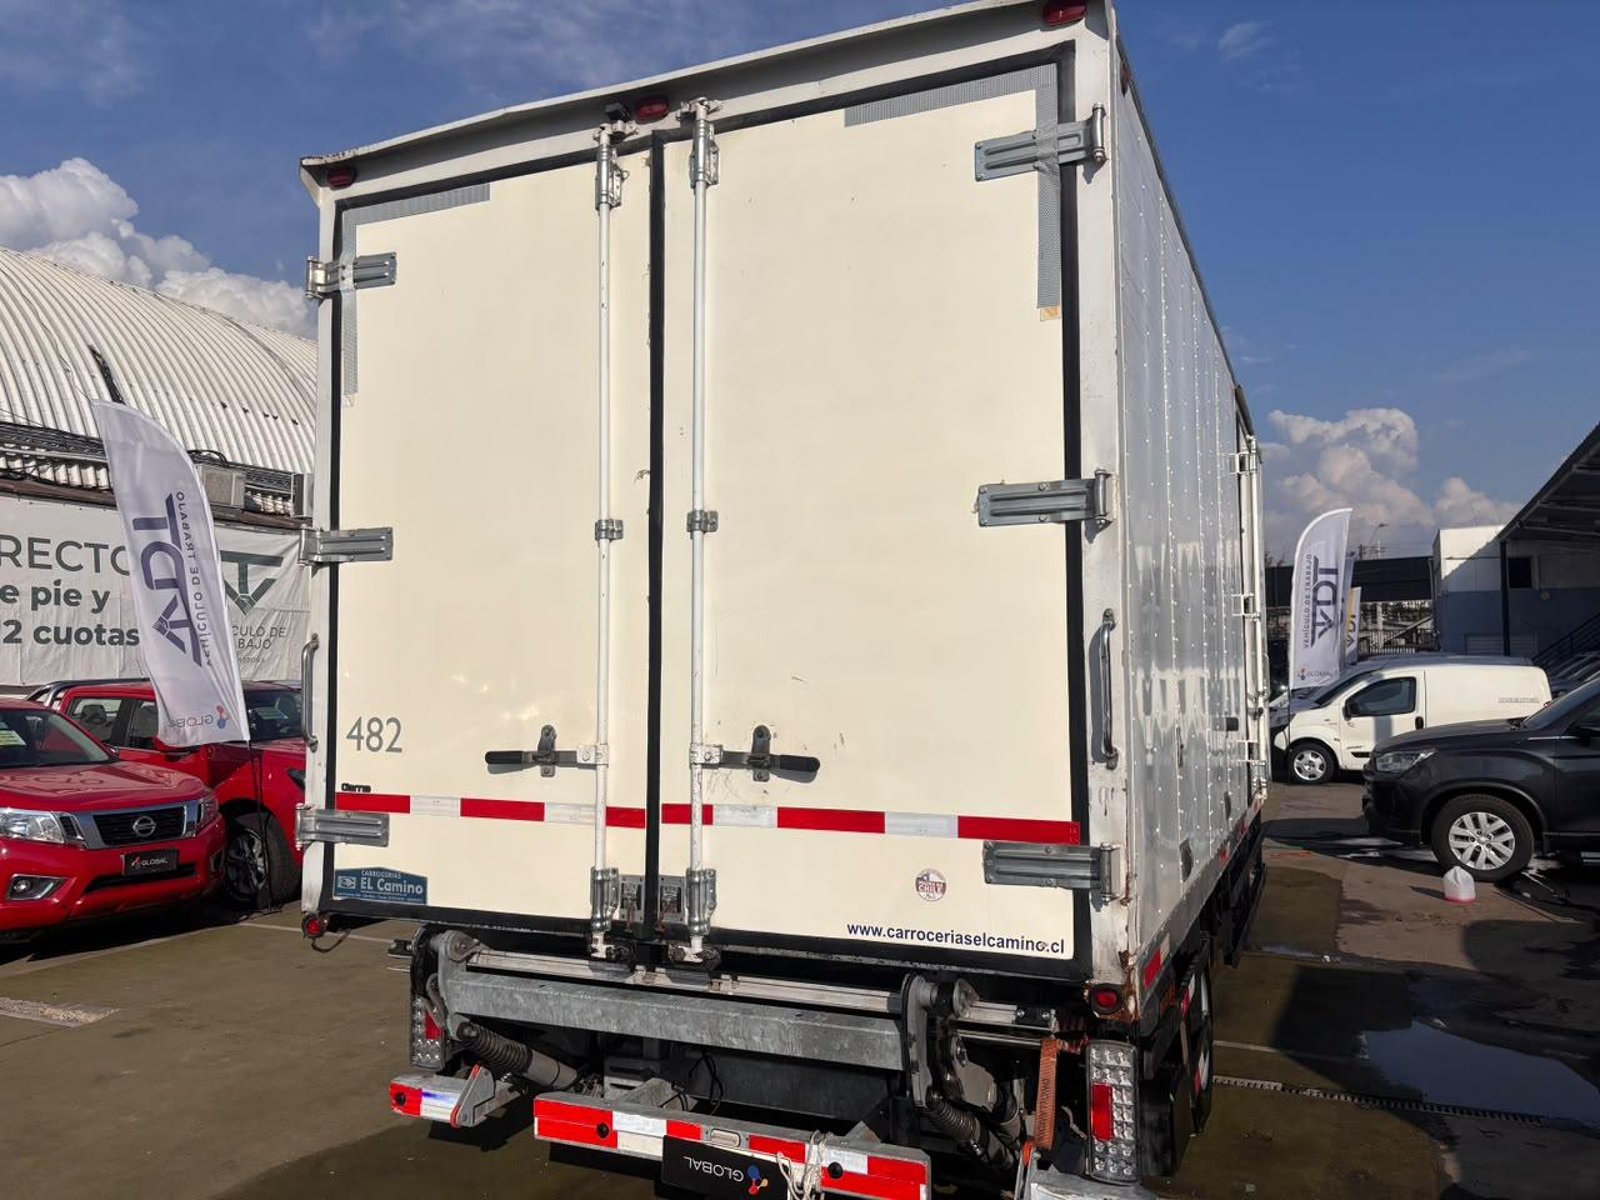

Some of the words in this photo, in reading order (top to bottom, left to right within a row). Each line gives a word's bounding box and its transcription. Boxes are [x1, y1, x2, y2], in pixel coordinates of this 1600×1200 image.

[31, 579, 82, 611] pie
[91, 589, 110, 614] y
[3, 620, 22, 644] 2
[33, 624, 140, 646] cuotas
[269, 626, 286, 637] DE
[346, 716, 402, 753] 482
[360, 877, 374, 890] EL
[377, 879, 424, 895] Camino
[846, 923, 1065, 954] www.carroceriaselcamino.cl
[683, 1156, 744, 1182] GLOBAL
